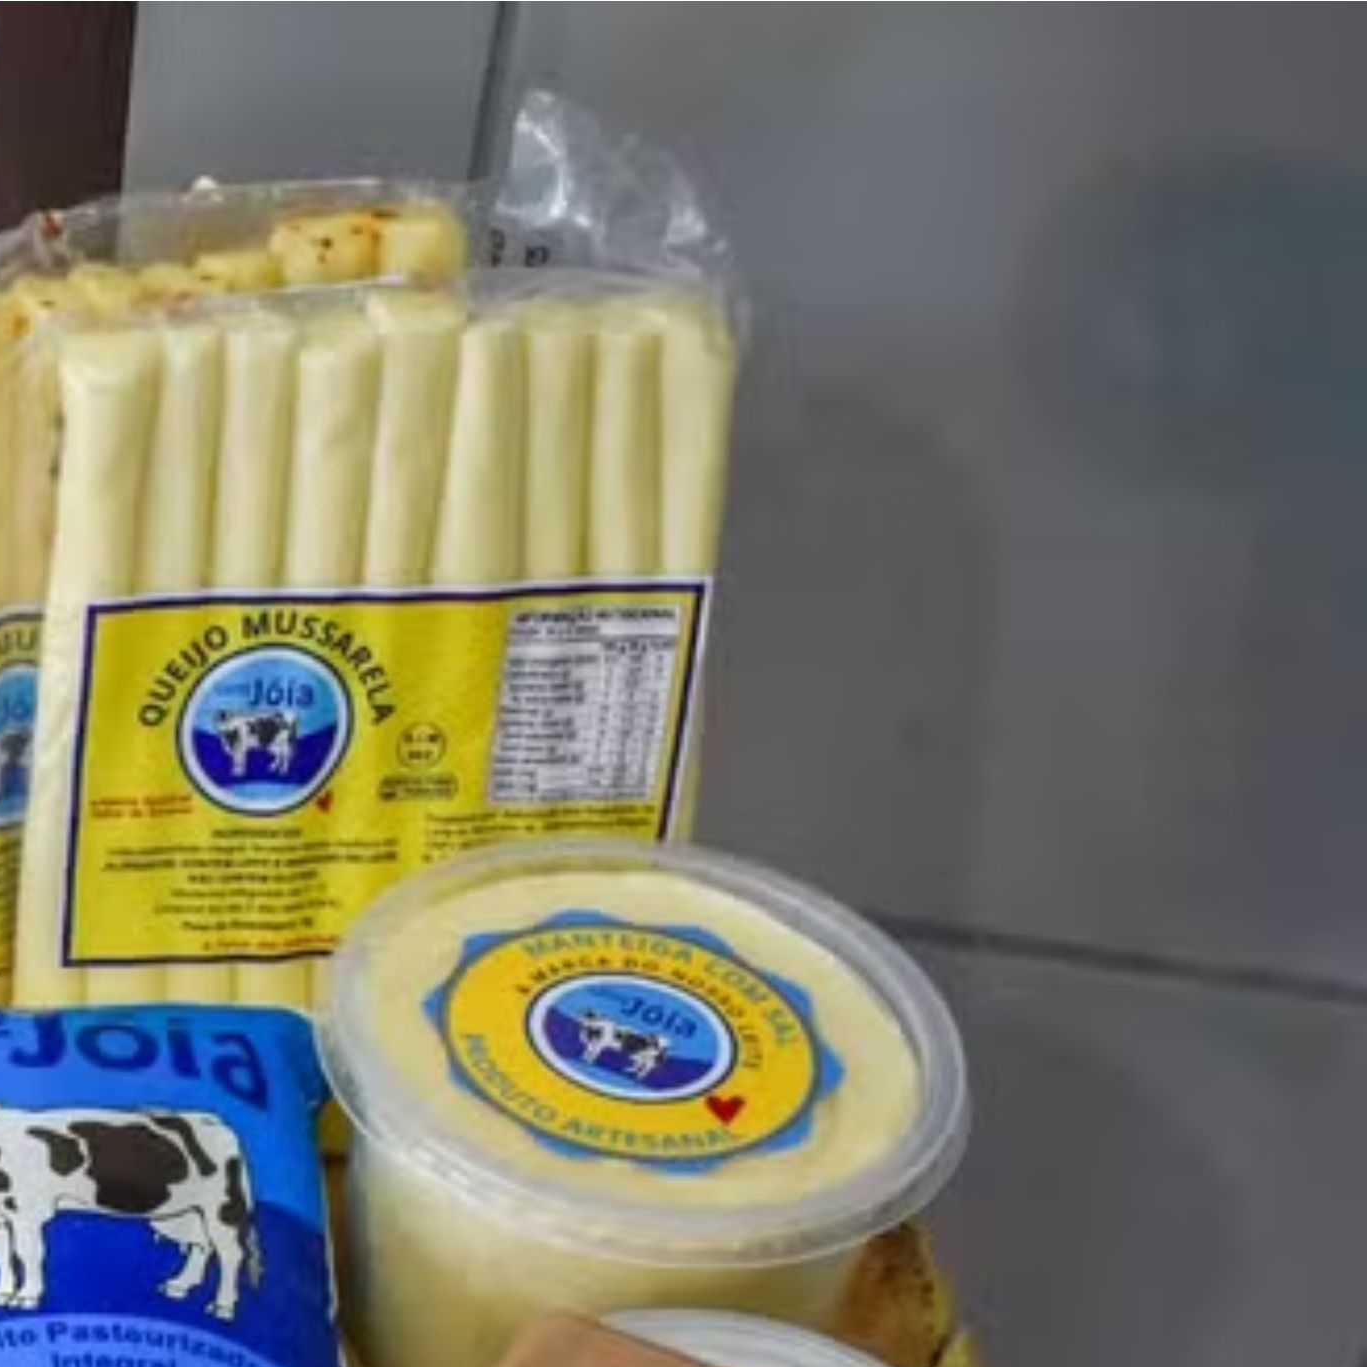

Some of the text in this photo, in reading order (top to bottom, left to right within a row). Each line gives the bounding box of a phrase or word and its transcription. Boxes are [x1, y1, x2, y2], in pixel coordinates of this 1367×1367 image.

[140, 625, 229, 729] QUEIJO
[241, 608, 397, 727] MUSSARELA
[249, 676, 315, 709] Jóia
[619, 996, 699, 1039] Jóia
